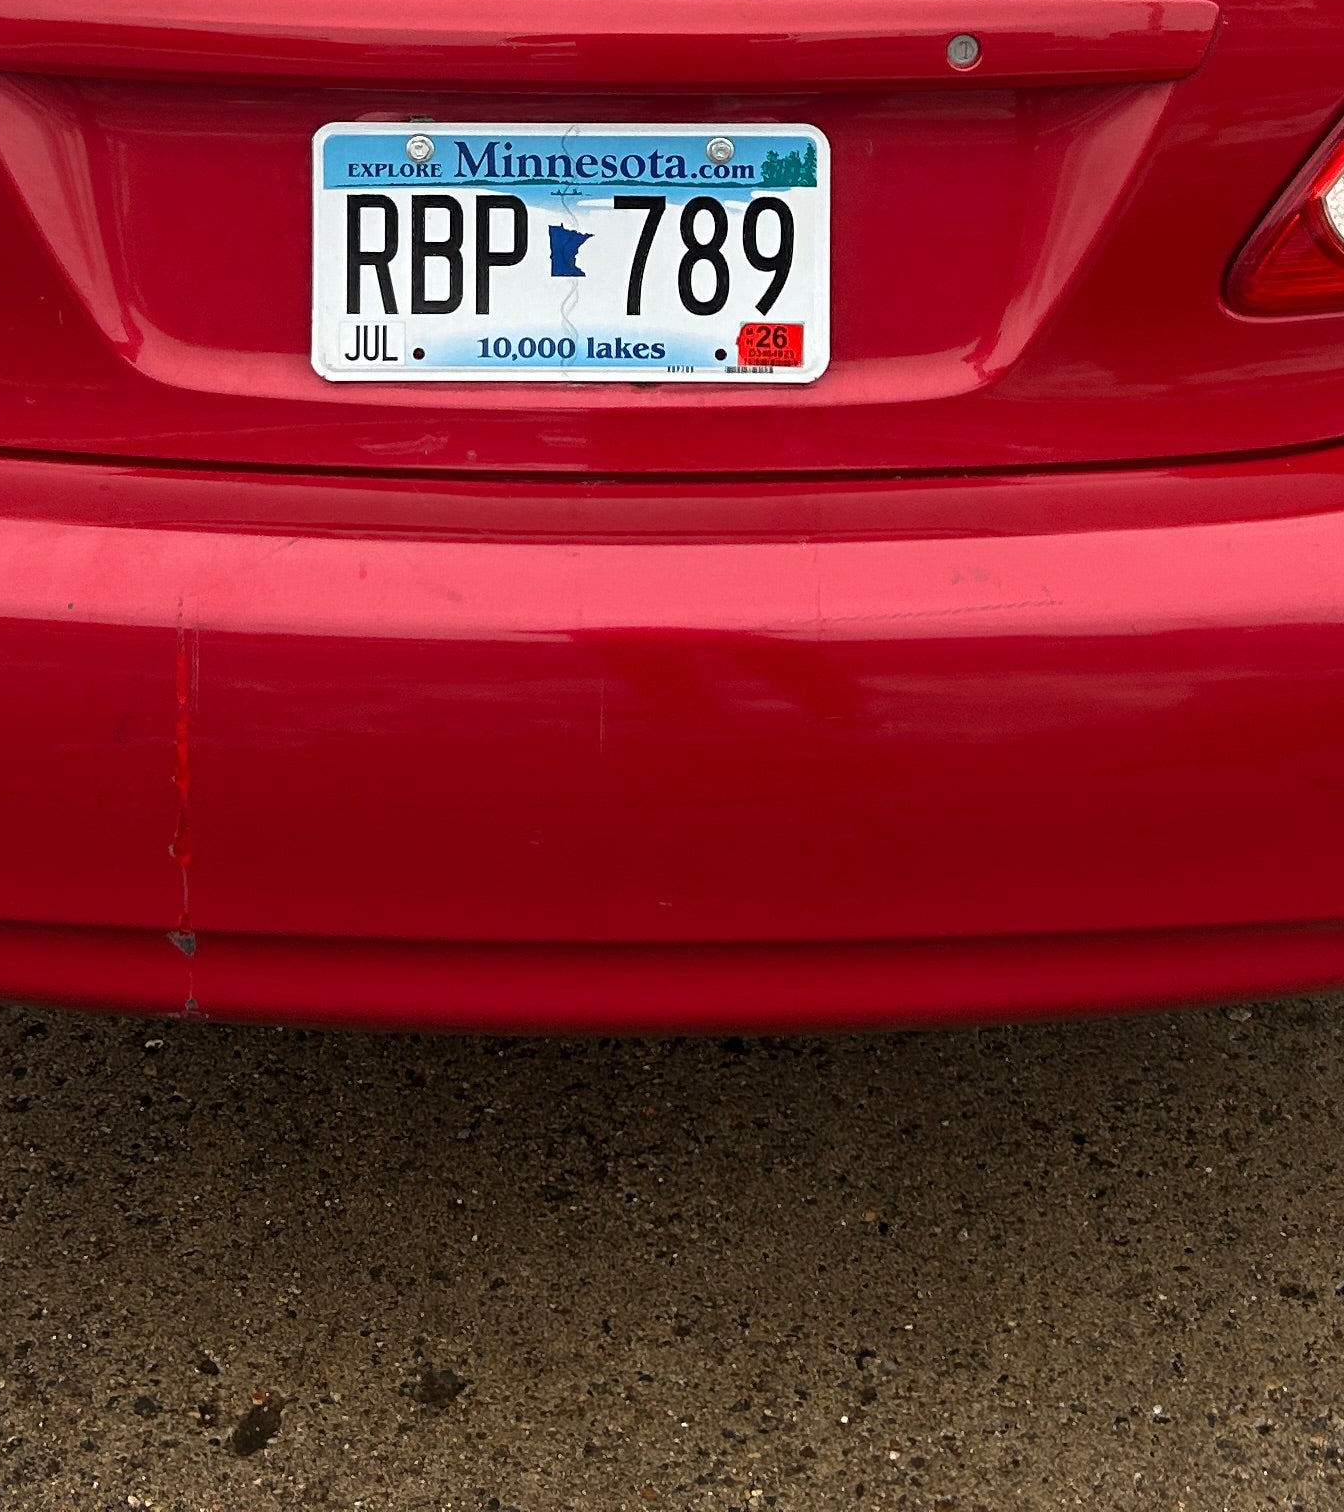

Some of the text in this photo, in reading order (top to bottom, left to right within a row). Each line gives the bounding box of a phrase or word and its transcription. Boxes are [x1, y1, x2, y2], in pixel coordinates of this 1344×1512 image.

[348, 141, 755, 180] EXPLORE Minnesota.com
[346, 194, 794, 316] RBP 789
[345, 325, 398, 362] JUL
[476, 337, 665, 361] 10,000 lakes
[756, 326, 788, 349] 26
